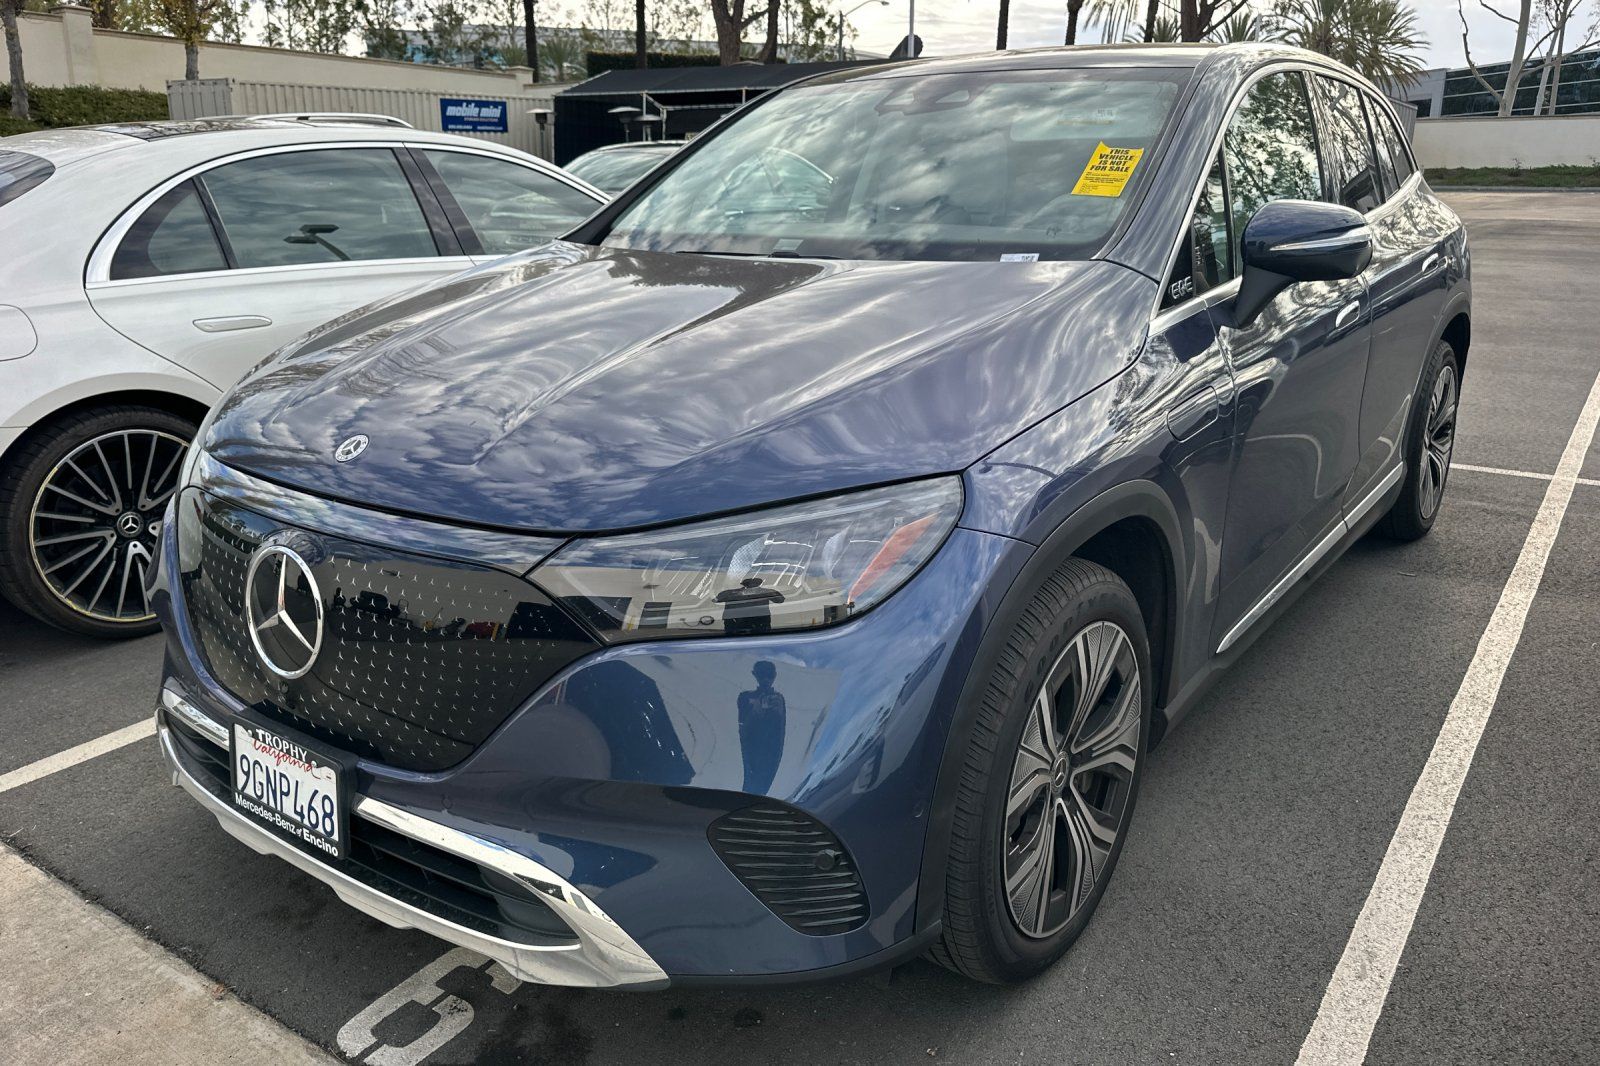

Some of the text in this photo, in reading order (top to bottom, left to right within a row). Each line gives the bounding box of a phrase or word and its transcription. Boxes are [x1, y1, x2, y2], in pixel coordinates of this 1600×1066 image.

[446, 102, 502, 118] mobile mini
[1099, 153, 1134, 161] VEHICLE
[255, 728, 308, 762] TROPHY
[240, 754, 335, 838] 9GNP468
[235, 792, 296, 834] Mercedes-Benz
[303, 828, 339, 857] Encino
